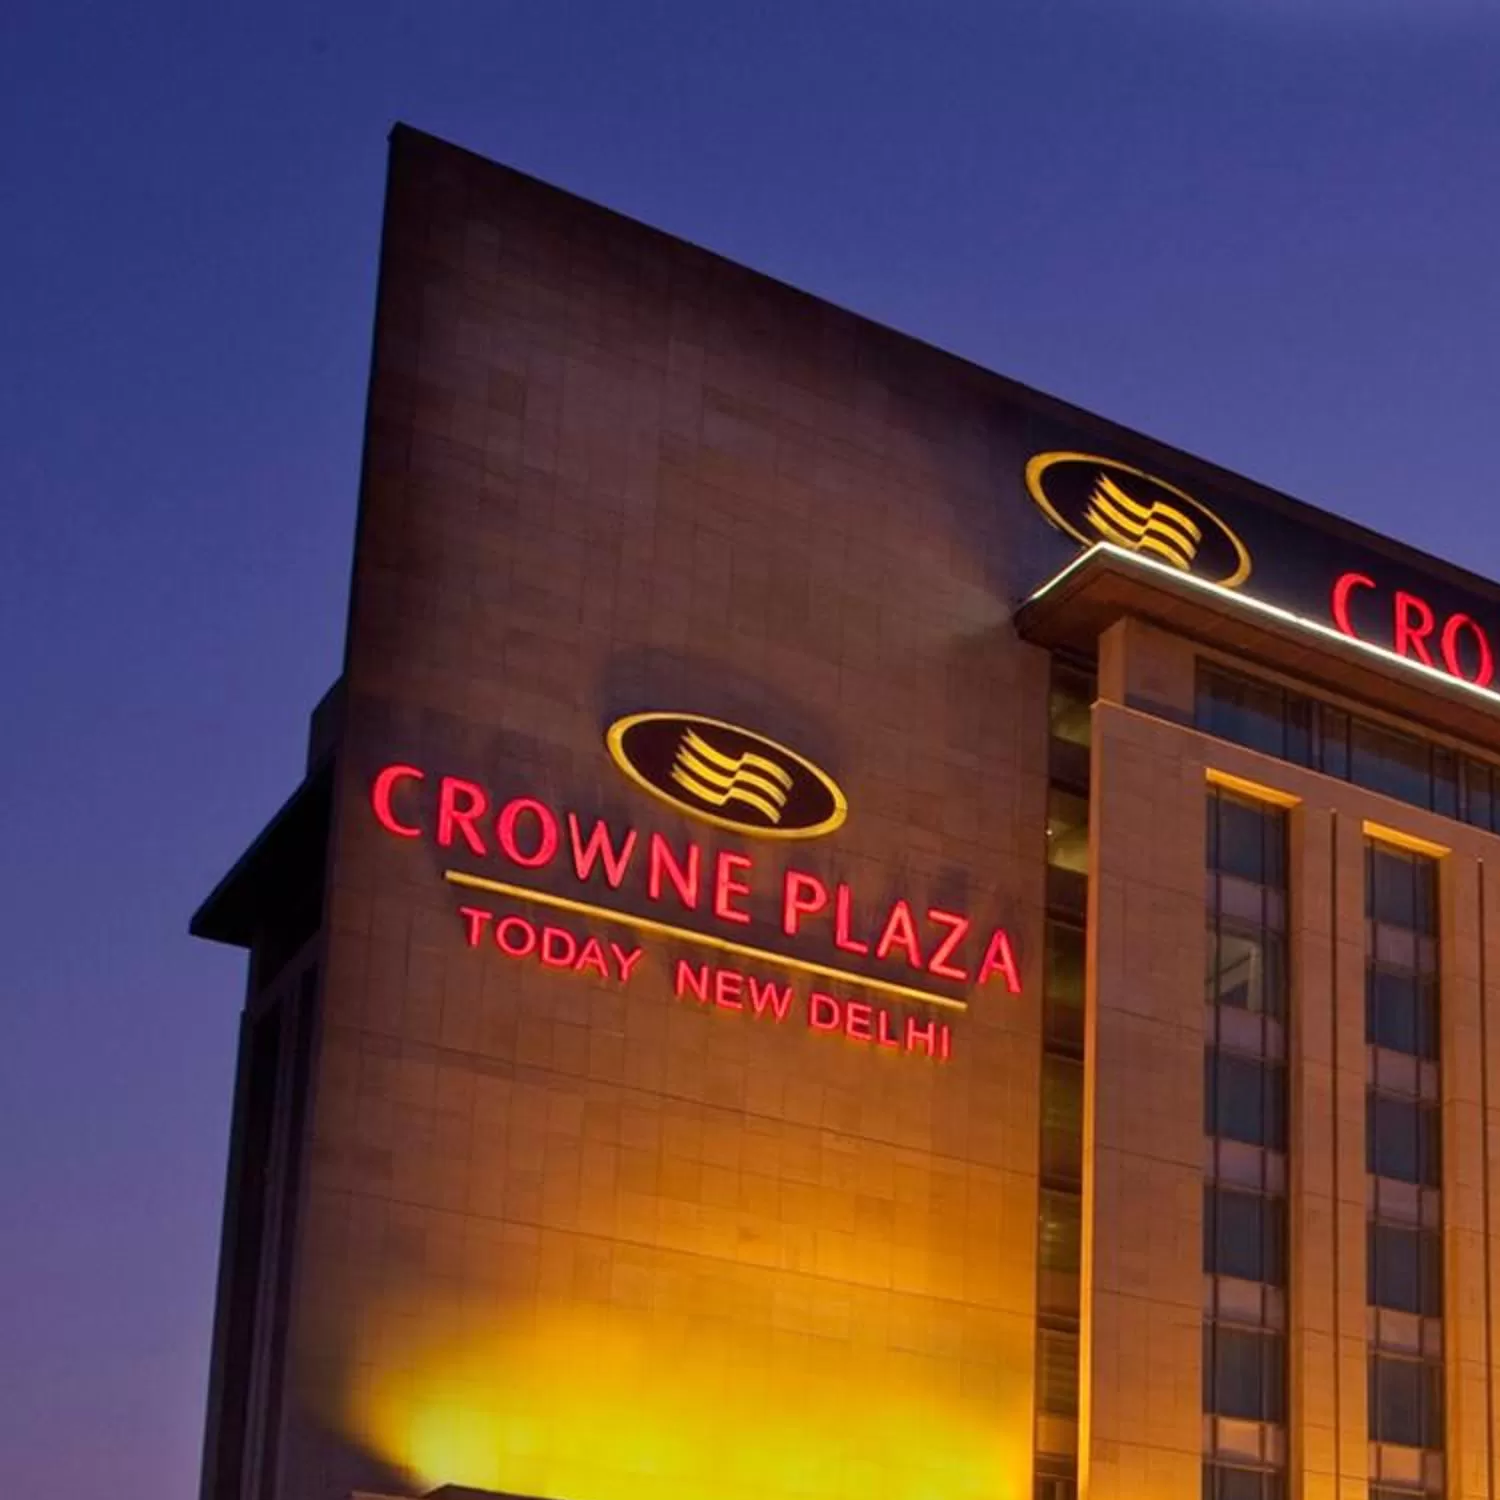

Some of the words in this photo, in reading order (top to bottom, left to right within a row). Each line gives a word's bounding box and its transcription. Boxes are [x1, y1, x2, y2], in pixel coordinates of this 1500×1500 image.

[371, 763, 756, 925] CROWNE
[782, 868, 1024, 998] PLAZA
[460, 905, 646, 986] TODAY
[673, 959, 798, 1022] NEW
[805, 988, 954, 1060] DELHI
